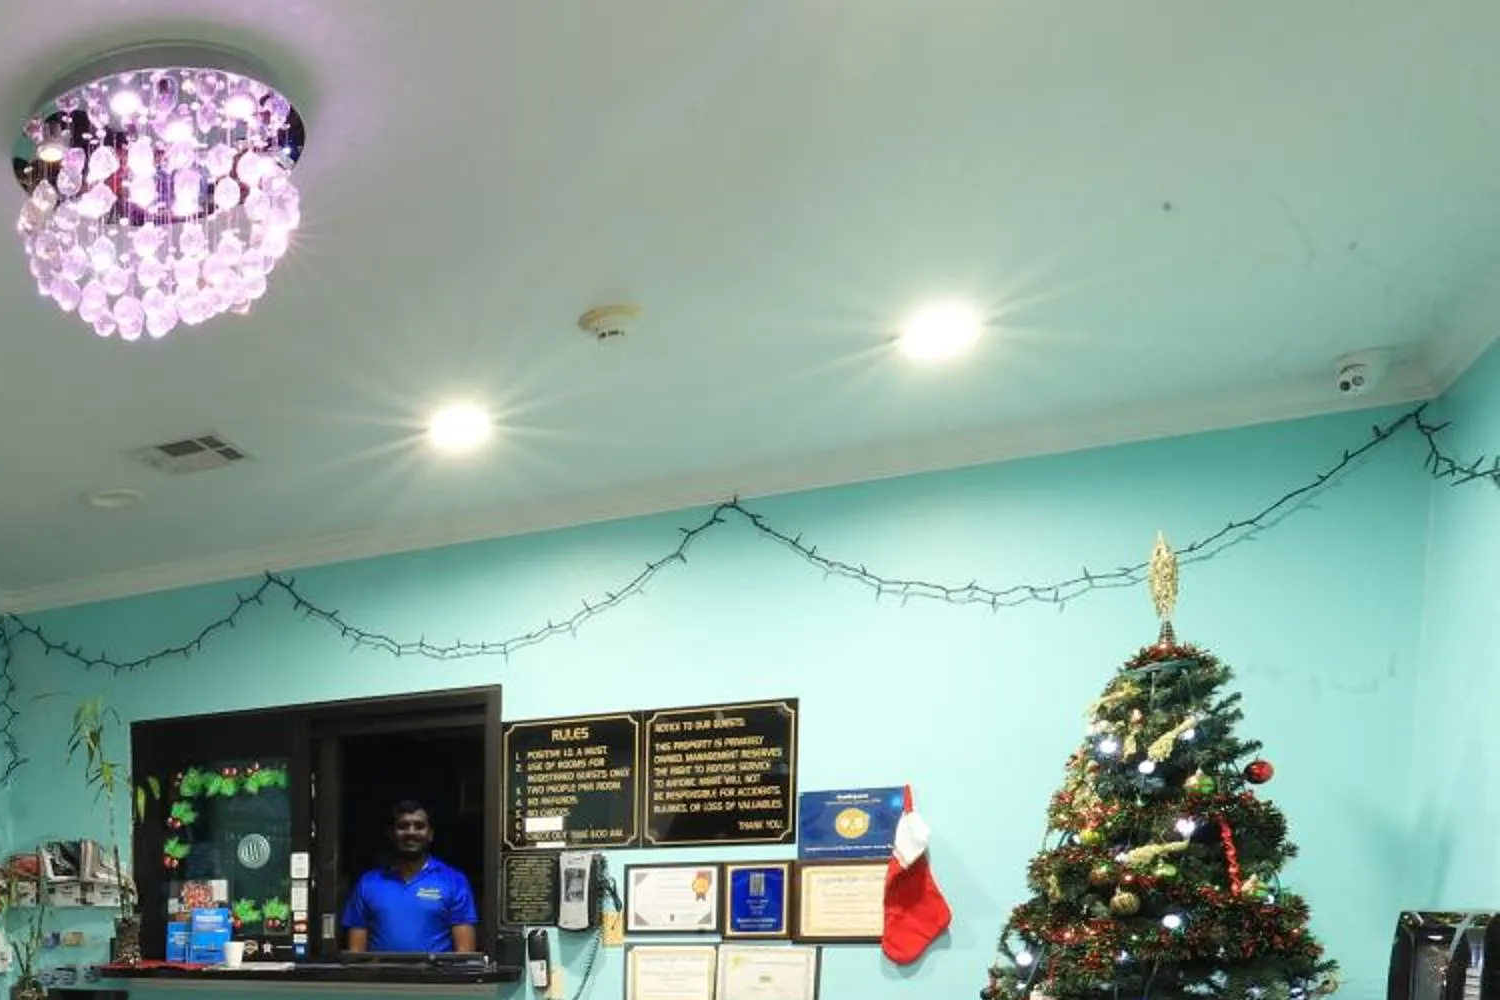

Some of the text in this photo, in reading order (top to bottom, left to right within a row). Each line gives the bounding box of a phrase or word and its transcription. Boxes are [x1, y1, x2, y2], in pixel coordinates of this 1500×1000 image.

[654, 722, 680, 732] NOTICE
[682, 721, 693, 731] TO
[551, 727, 589, 741] RULES
[673, 740, 713, 751] PROPERTY
[714, 738, 723, 748] IS
[575, 747, 583, 757] A
[685, 750, 739, 762] MANAGEMENT
[740, 747, 782, 758] RESERVES
[694, 764, 705, 774] TO
[653, 779, 665, 788] TO
[527, 784, 545, 794] TWO
[719, 787, 736, 797] FOR
[527, 797, 539, 806] NO
[689, 802, 701, 812] OR
[702, 801, 723, 811] LOSS
[527, 808, 539, 817] NO
[738, 820, 764, 830] THANK
